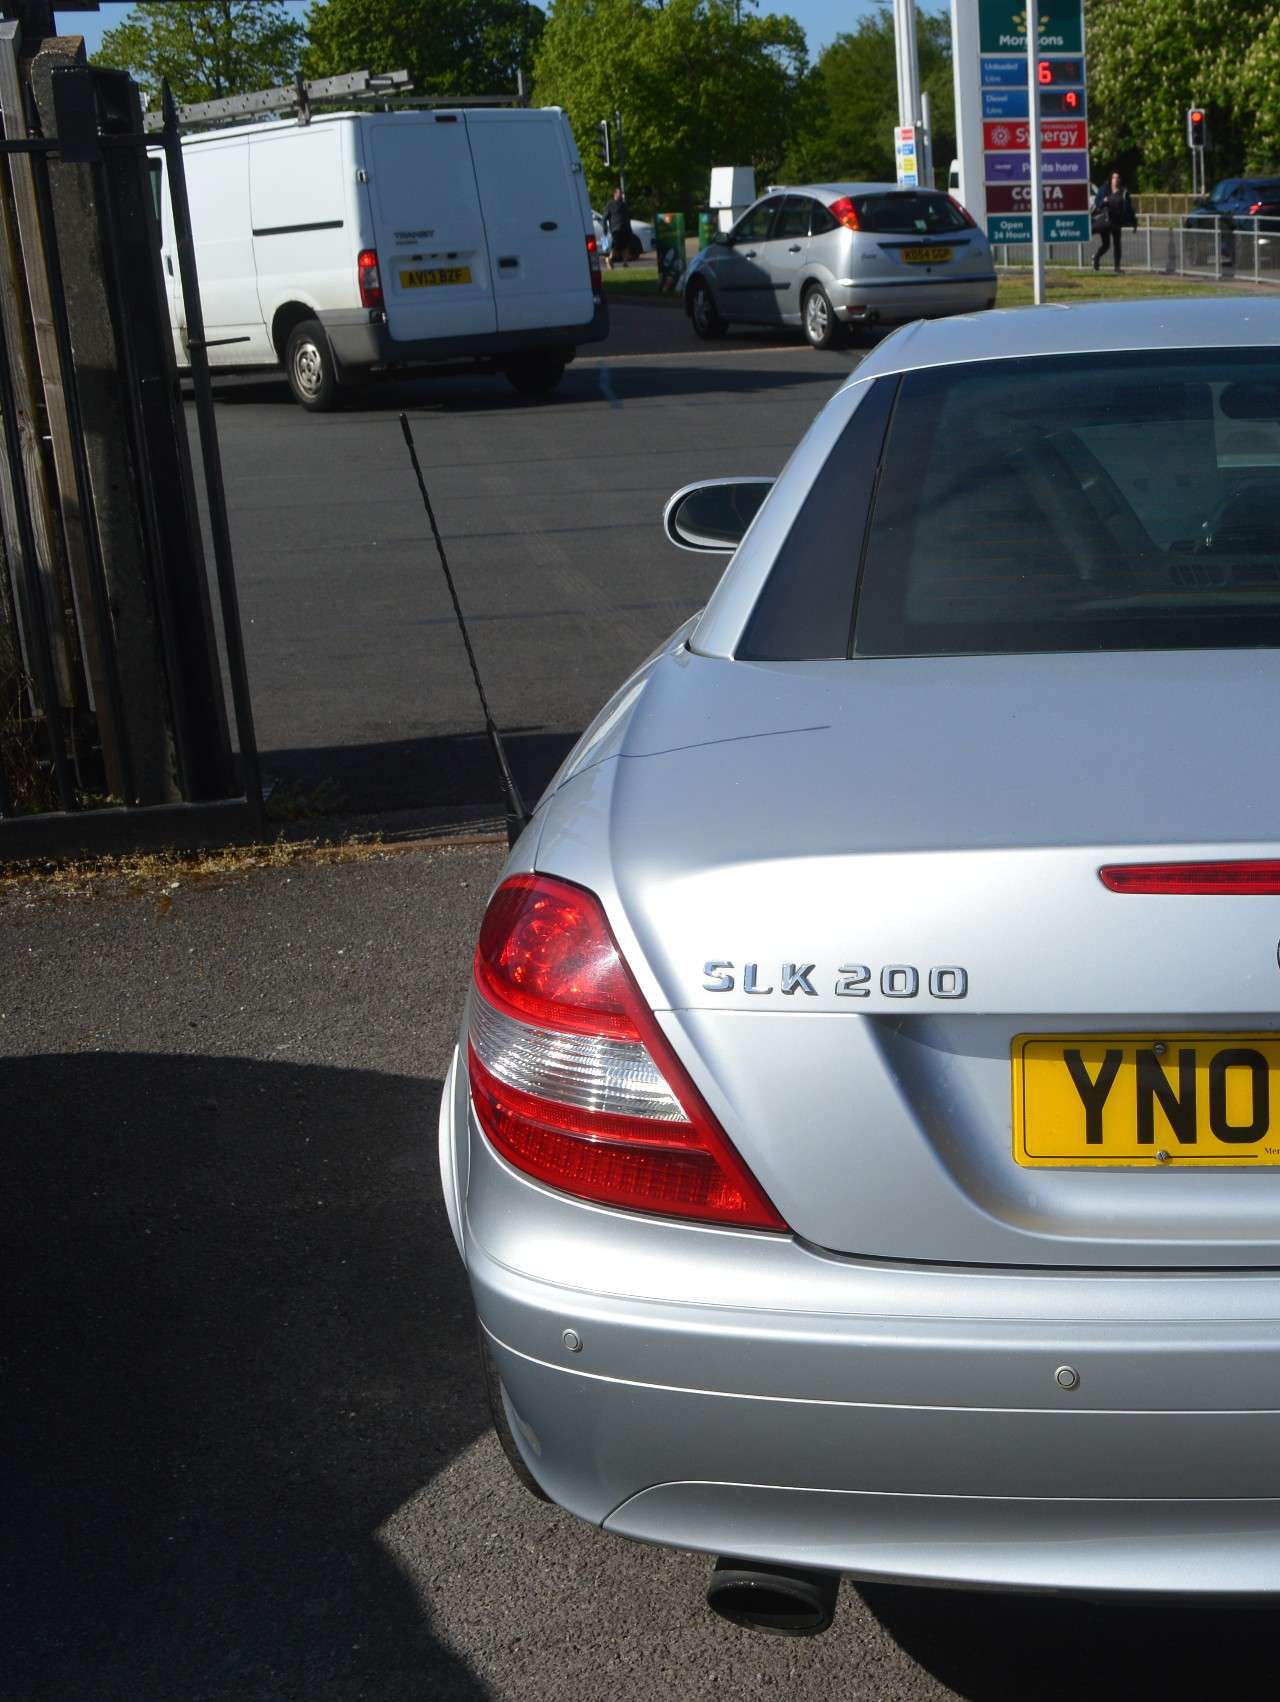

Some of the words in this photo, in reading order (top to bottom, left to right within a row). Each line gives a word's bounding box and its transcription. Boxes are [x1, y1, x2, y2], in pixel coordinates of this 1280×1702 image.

[1000, 34, 1064, 46] Morons
[1016, 128, 1078, 146] Syergy
[1055, 162, 1078, 172] here
[1012, 186, 1063, 200] COTA
[1000, 221, 1023, 230] Open
[1056, 219, 1074, 228] Beer
[1006, 230, 1030, 239] Hours
[1059, 229, 1080, 238] Wine
[702, 959, 819, 996] SLK
[834, 962, 969, 1000] 200
